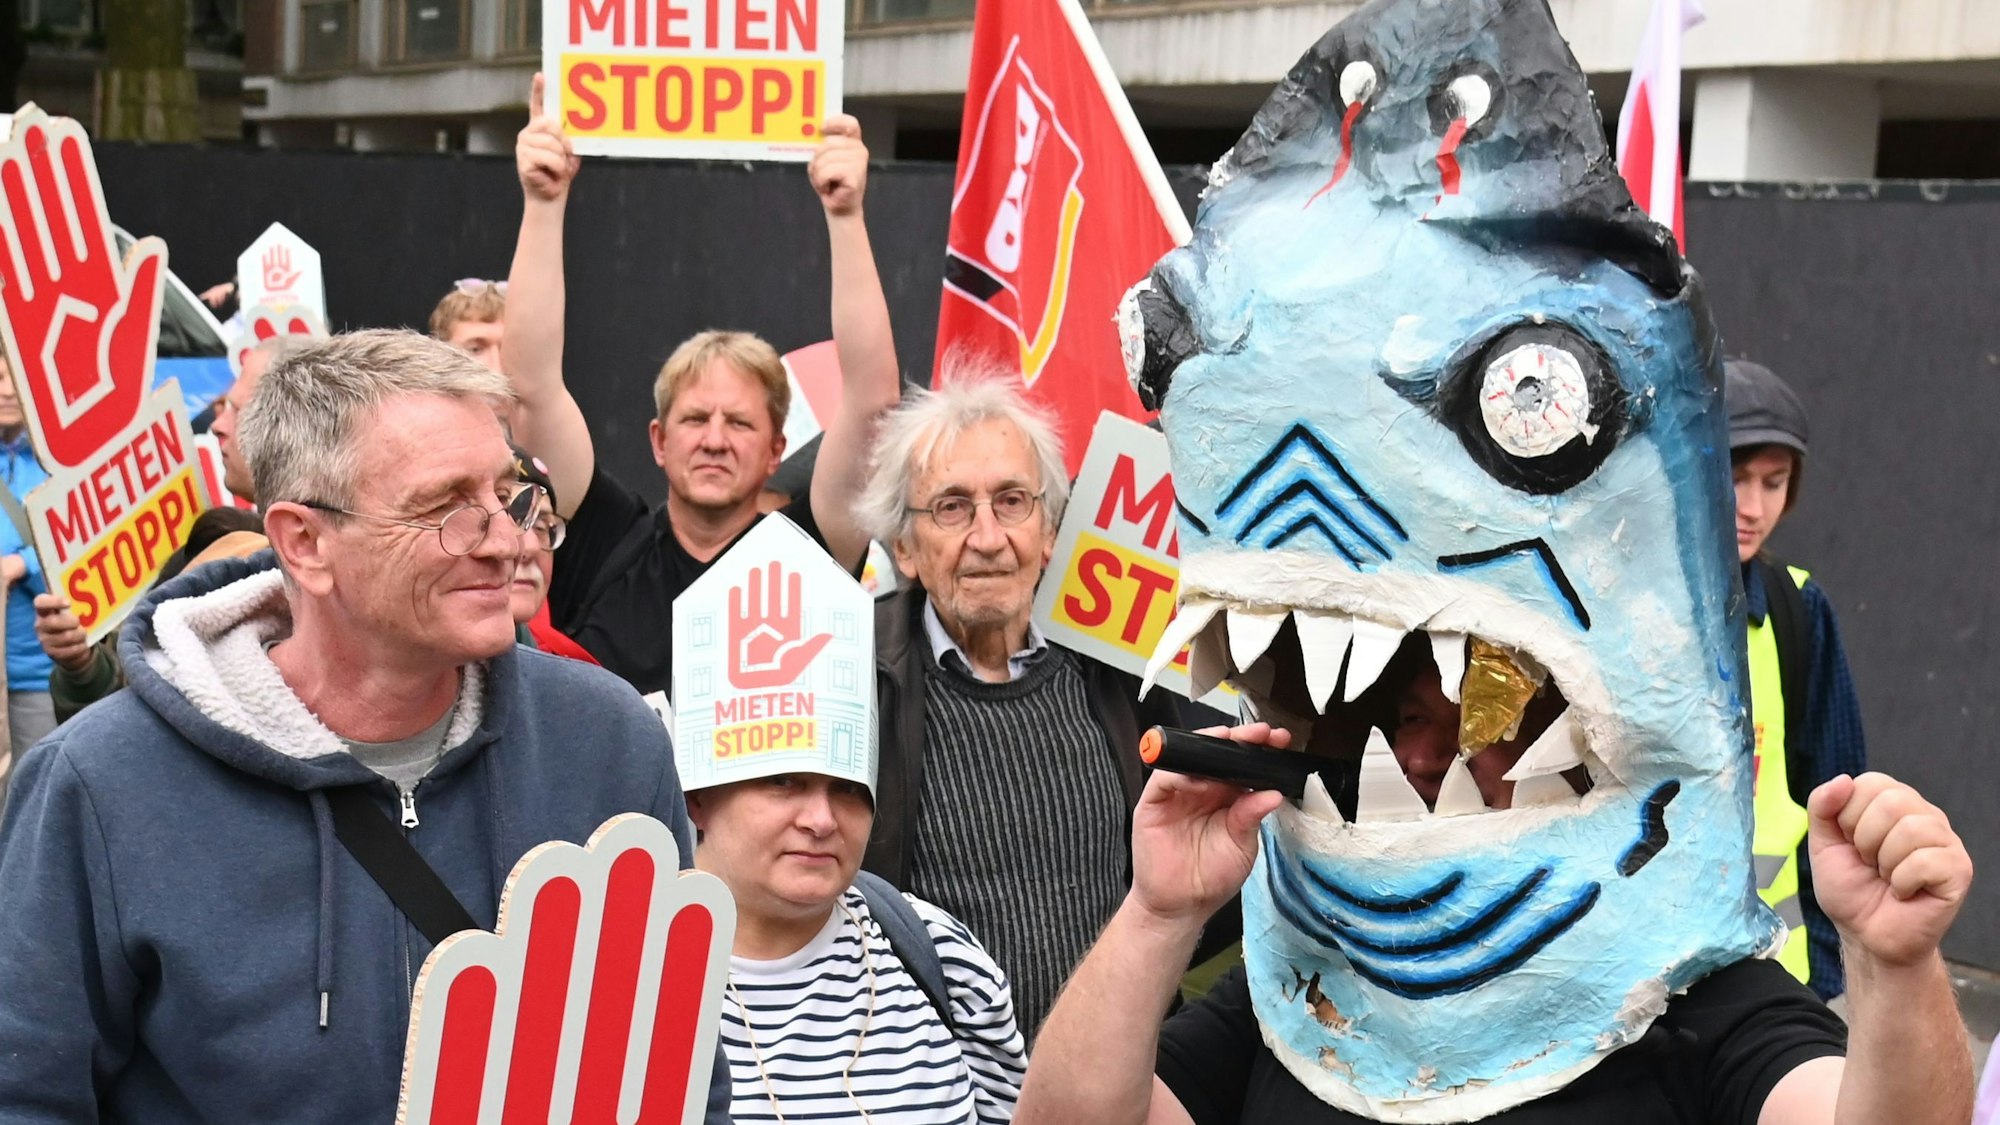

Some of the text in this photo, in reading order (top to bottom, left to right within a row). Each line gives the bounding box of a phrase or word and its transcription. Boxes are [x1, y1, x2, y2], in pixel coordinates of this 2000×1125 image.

[568, 0, 818, 52] MIETEN
[566, 62, 817, 137] STOPP!
[45, 410, 186, 564] MIETEN
[714, 692, 814, 725] MIETEN
[715, 722, 814, 758] STOPP!
